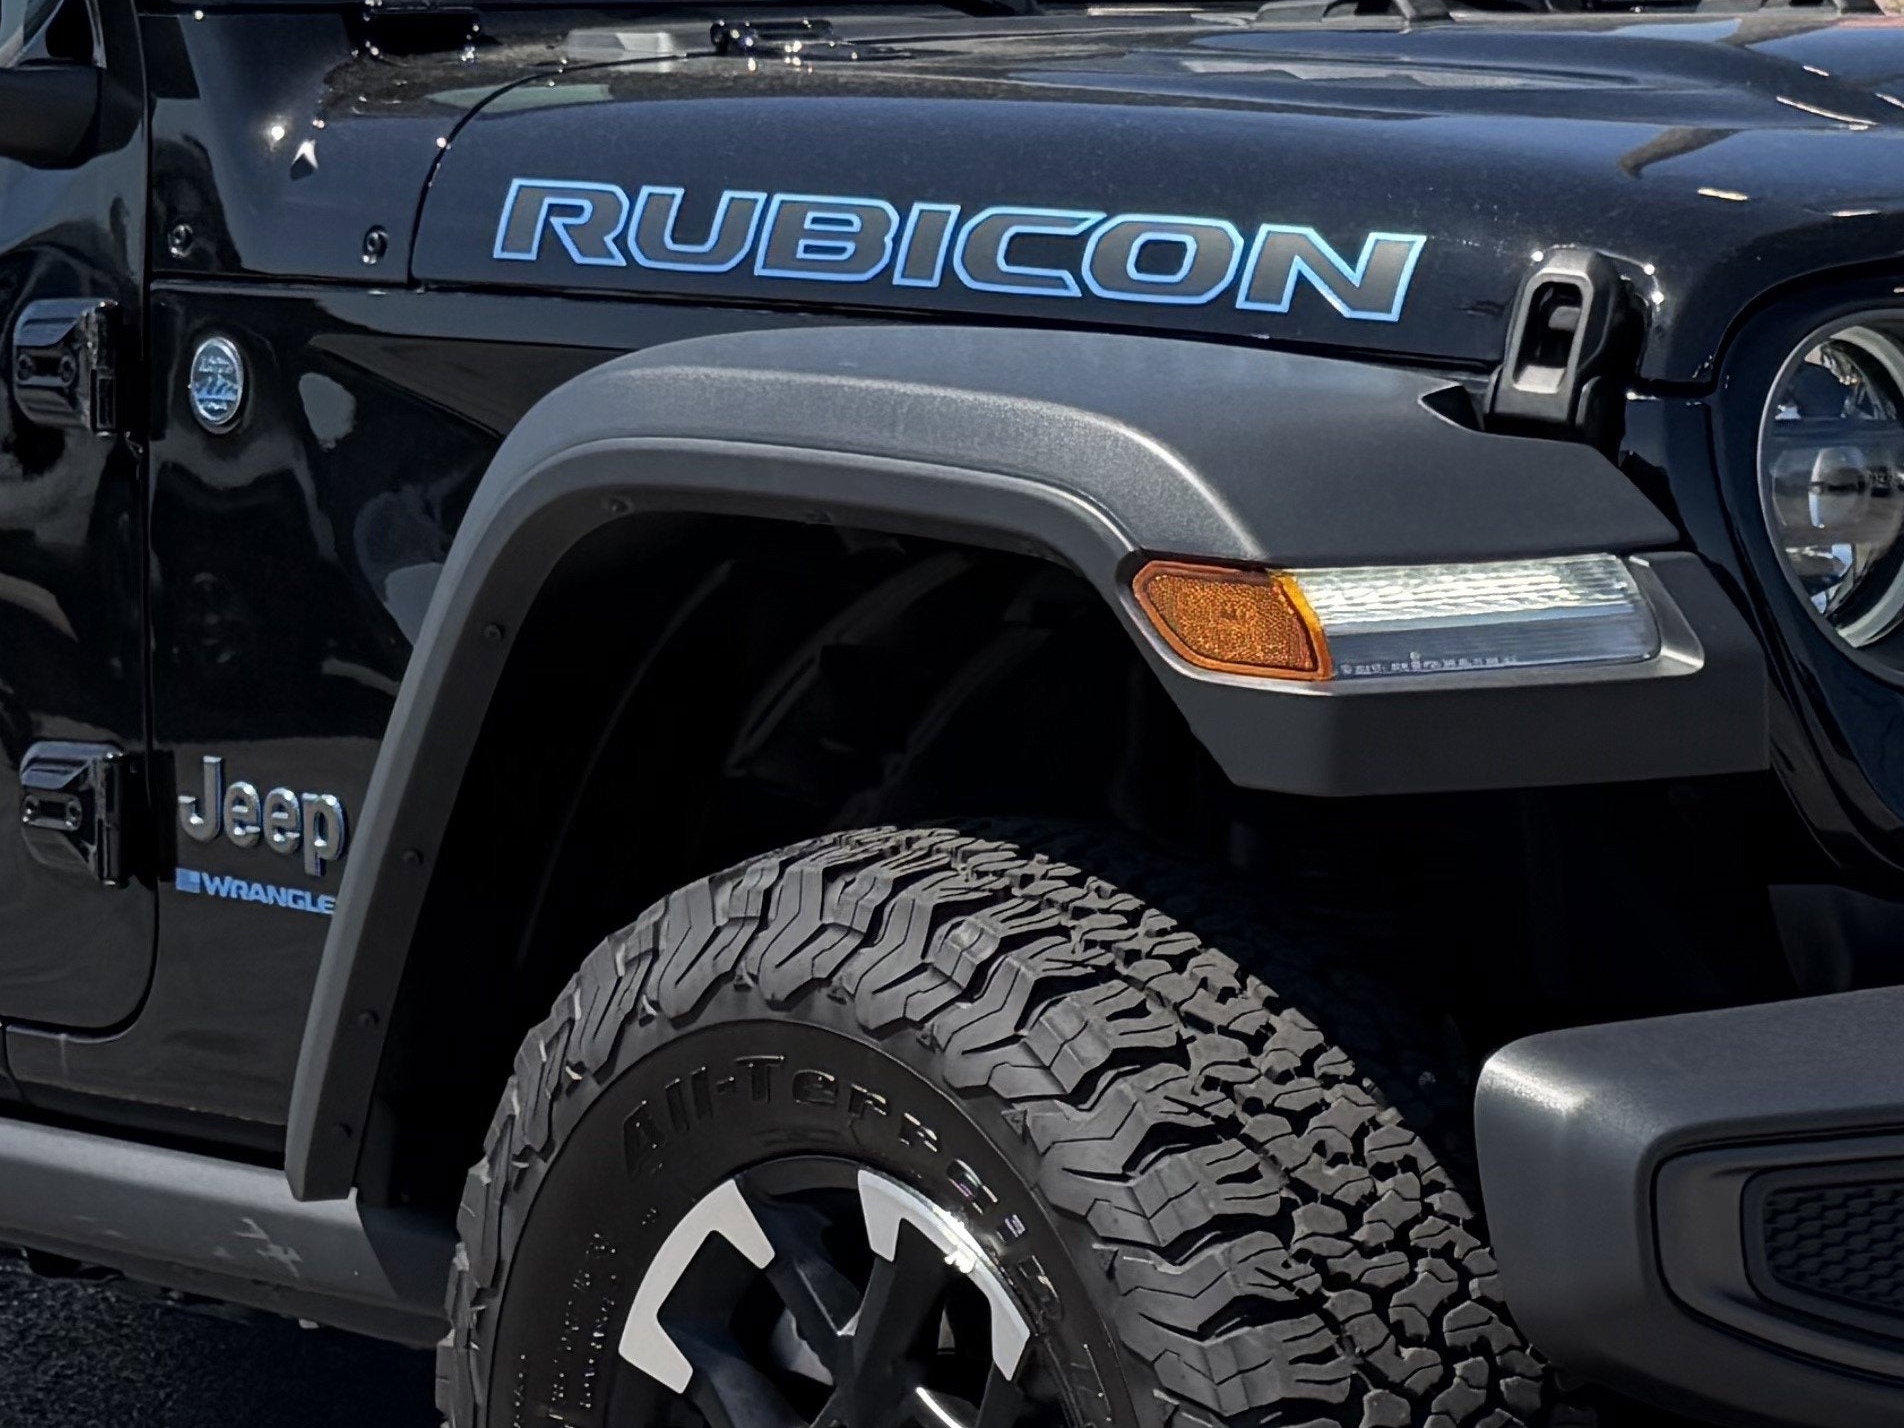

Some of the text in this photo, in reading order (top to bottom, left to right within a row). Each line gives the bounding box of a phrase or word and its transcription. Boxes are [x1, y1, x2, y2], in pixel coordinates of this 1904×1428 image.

[492, 177, 1426, 322] RUBICON
[177, 755, 348, 877] Jeep
[201, 871, 337, 915] WRANGLE
